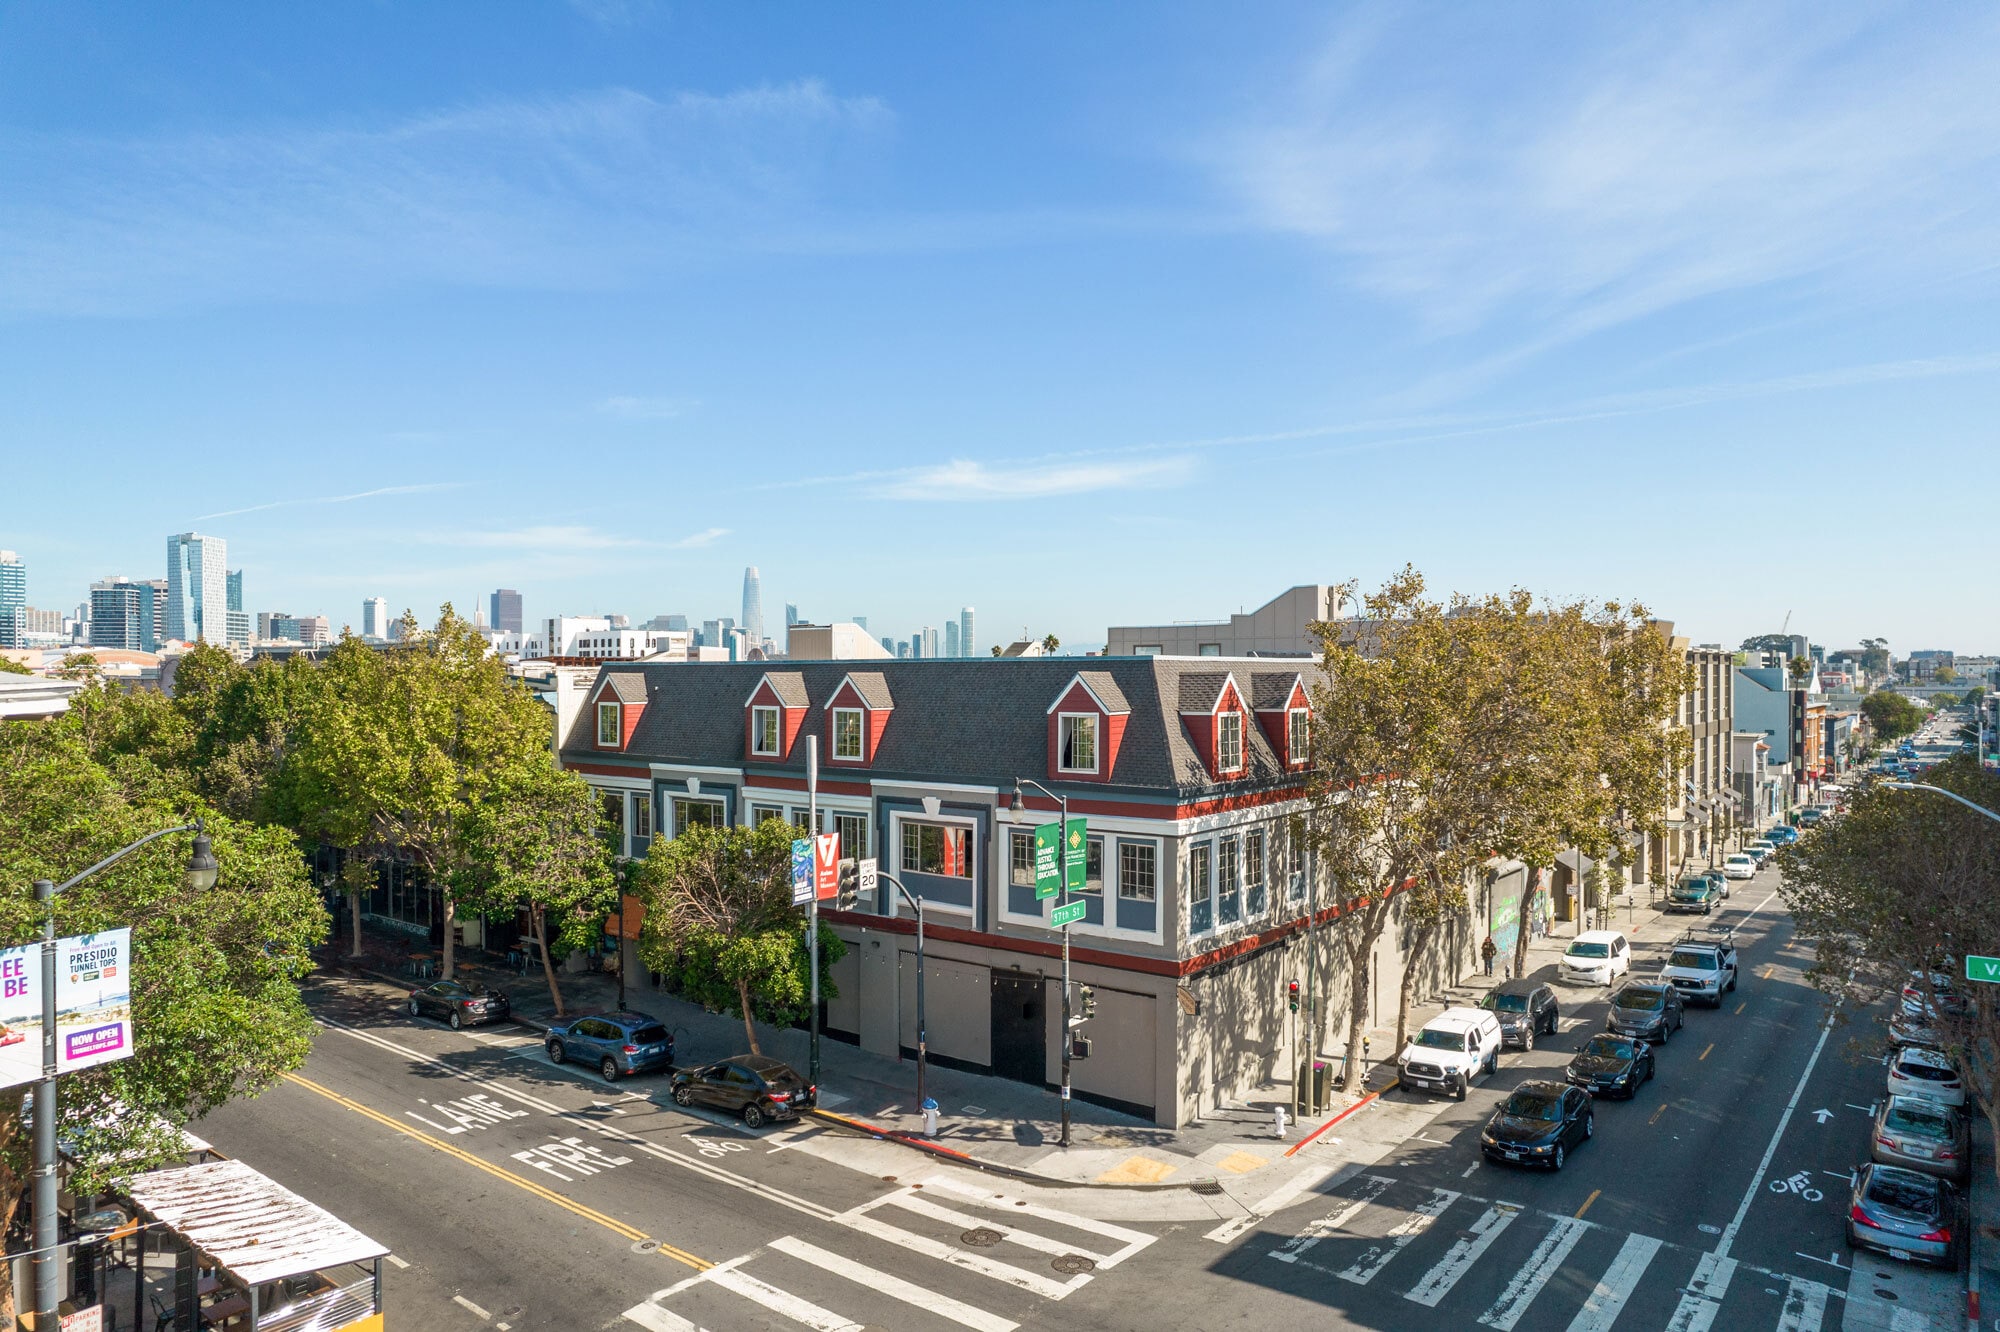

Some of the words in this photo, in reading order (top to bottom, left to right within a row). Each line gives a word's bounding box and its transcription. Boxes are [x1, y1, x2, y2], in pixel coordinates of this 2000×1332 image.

[862, 874, 875, 886] 20
[70, 947, 117, 964] PRESIDIO
[70, 961, 97, 972] TUNNEL
[100, 958, 116, 967] TOPS
[0, 957, 24, 979] EE
[5, 977, 28, 997] BE
[72, 1033, 94, 1046] NOW
[95, 1027, 118, 1040] OPEN
[404, 1093, 530, 1135] LANE
[510, 1136, 634, 1182] FIRE
[75, 1309, 99, 1320] PARKING
